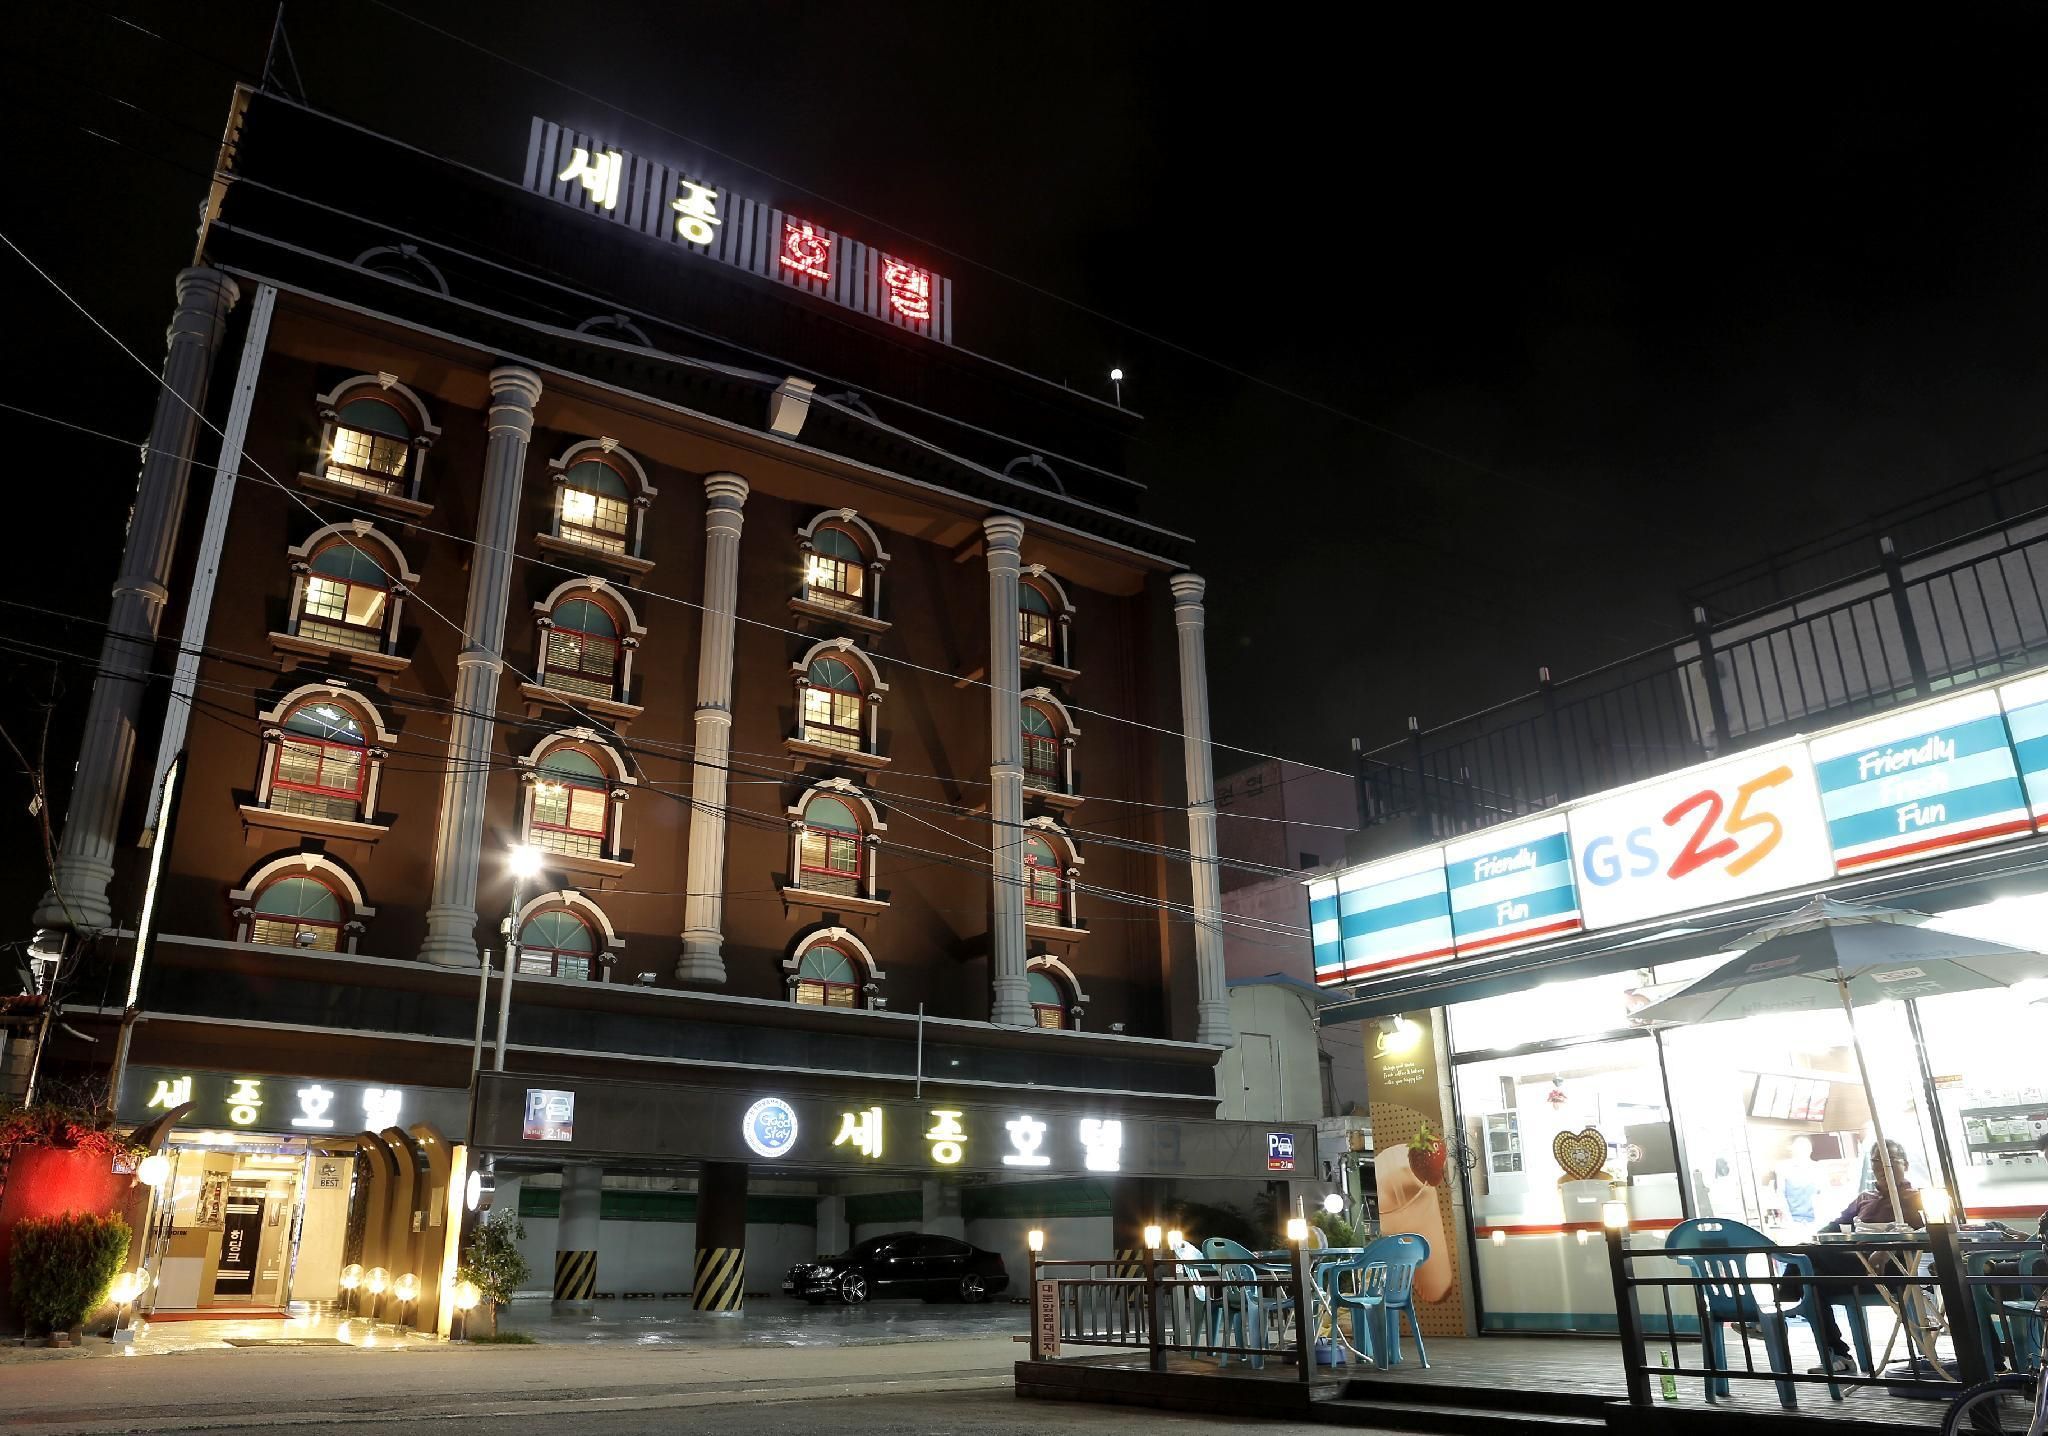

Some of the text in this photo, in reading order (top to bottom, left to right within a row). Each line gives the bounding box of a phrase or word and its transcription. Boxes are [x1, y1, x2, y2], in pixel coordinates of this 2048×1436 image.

[1858, 735, 1955, 780] Friendly
[1583, 765, 1793, 886] GS25
[1897, 802, 1946, 832] Fun
[1473, 848, 1536, 881] Friendly
[1496, 901, 1529, 926] Fun
[760, 1111, 791, 1127] Good
[764, 1126, 791, 1143] Stay
[320, 1179, 340, 1187] BEST
[226, 1229, 244, 1262] 히딩크
